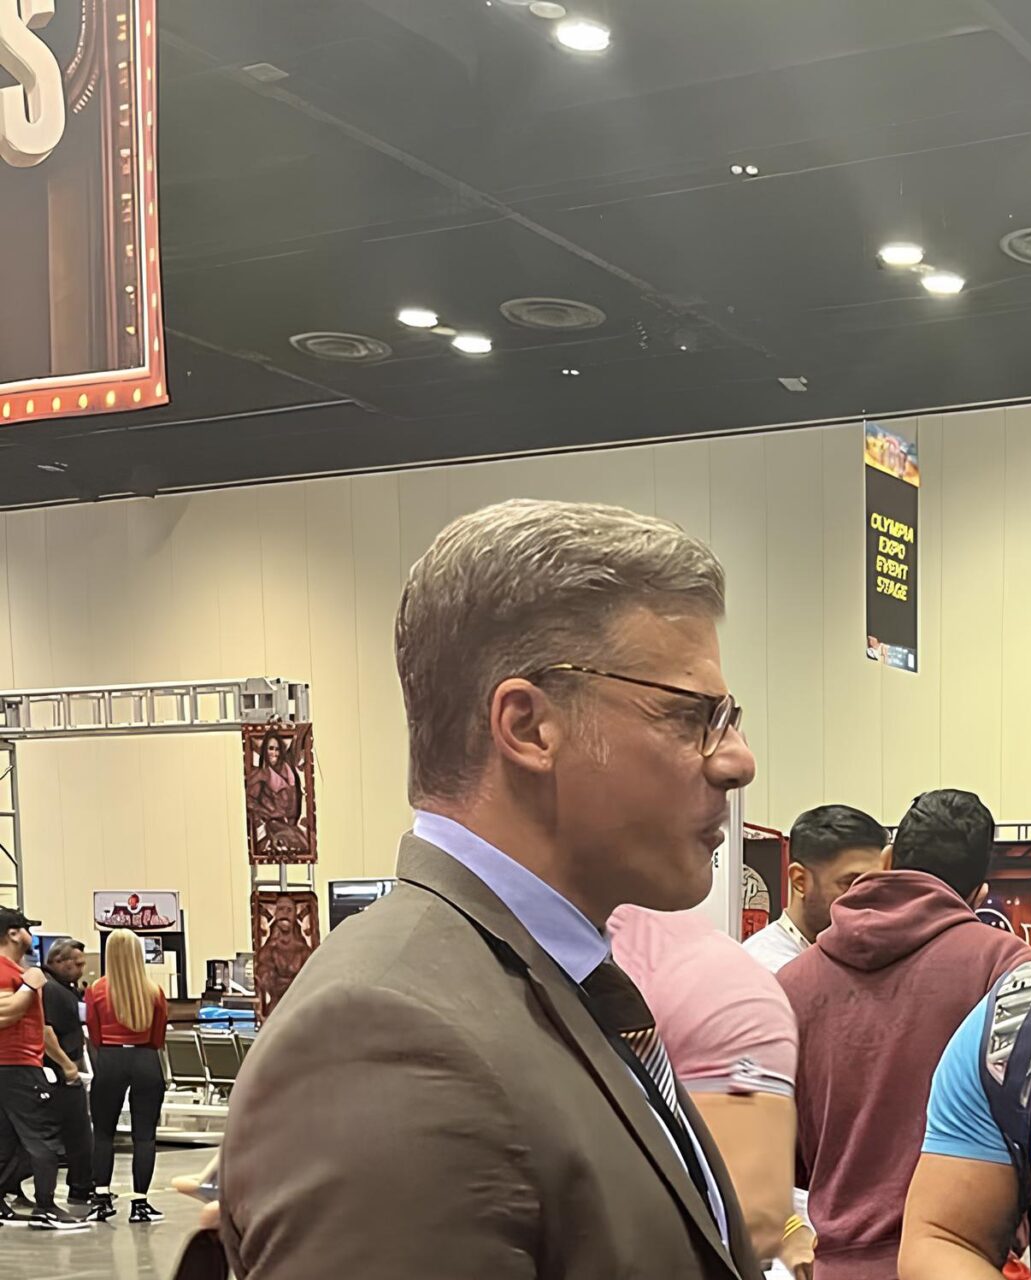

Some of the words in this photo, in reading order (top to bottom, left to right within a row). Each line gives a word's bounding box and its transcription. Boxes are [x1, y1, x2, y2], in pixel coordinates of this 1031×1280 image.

[870, 512, 914, 543] OLYMPIA
[878, 535, 906, 560] EXPO
[876, 554, 909, 580] EVENT
[876, 575, 908, 601] STAGE
